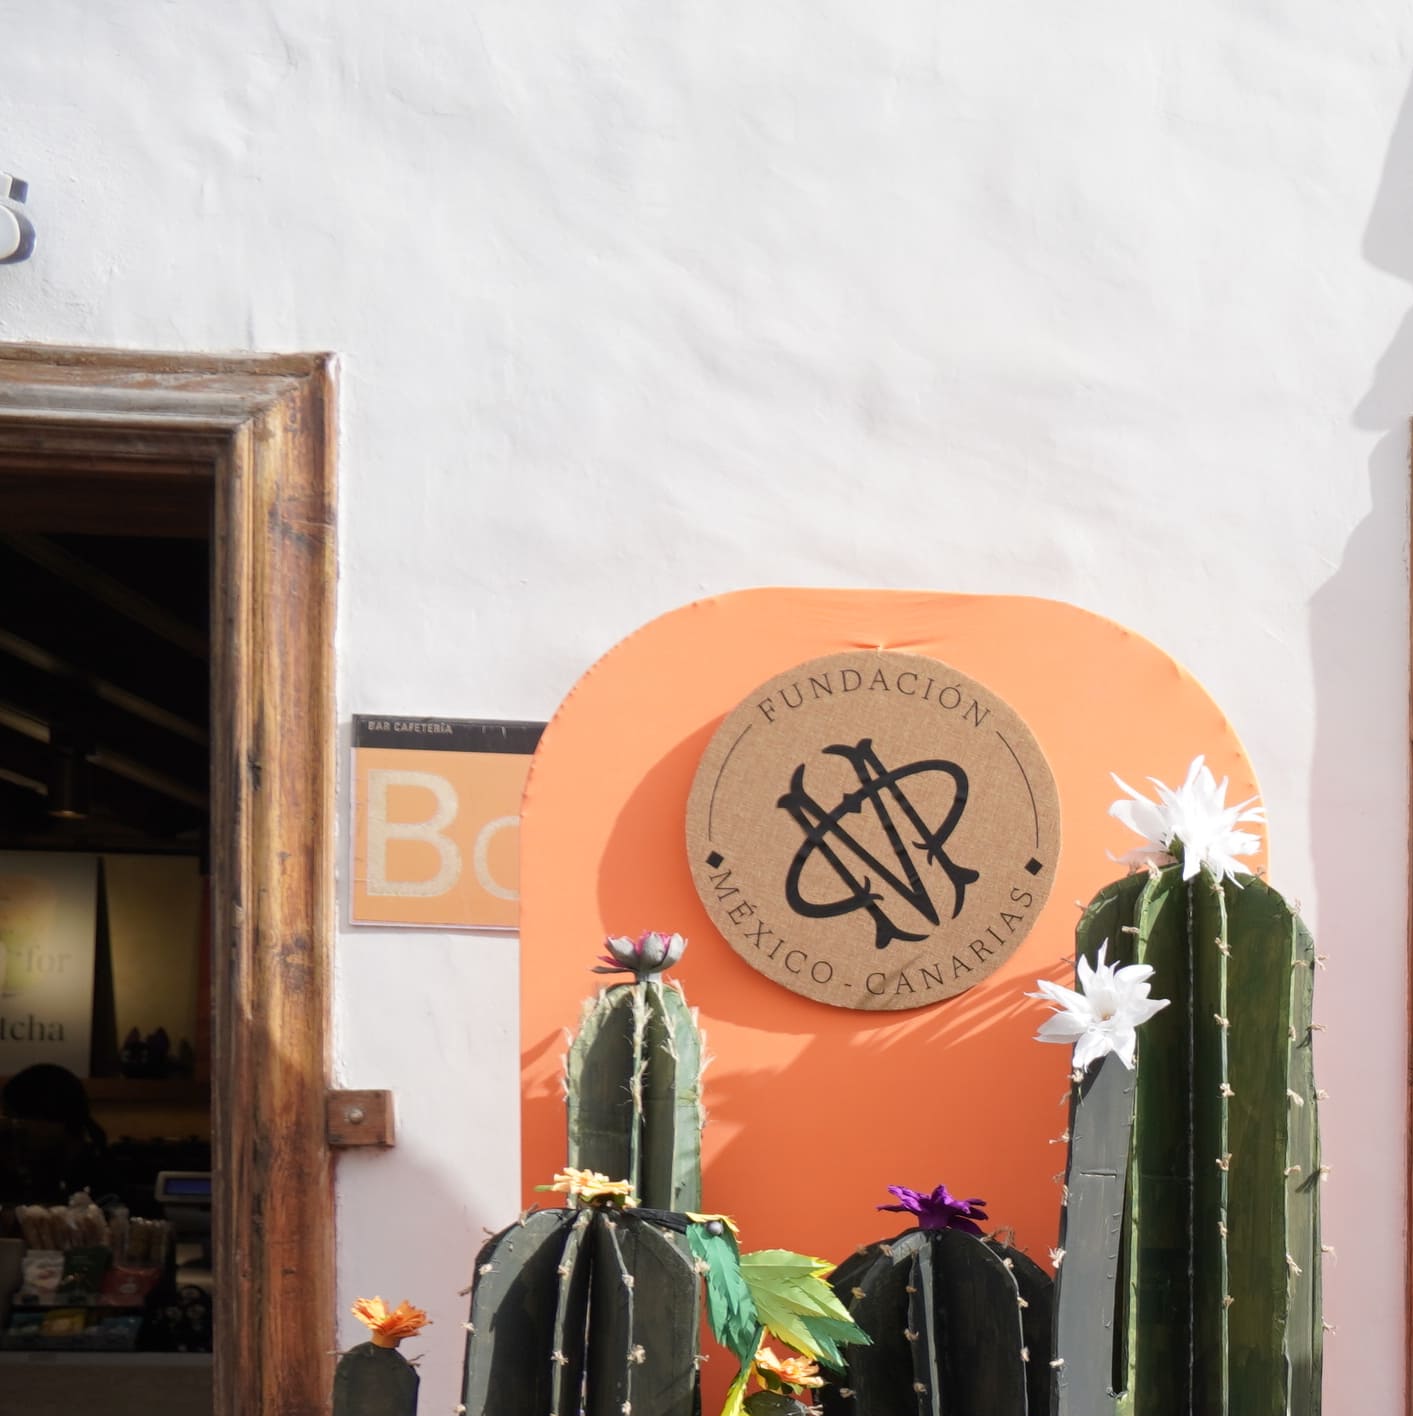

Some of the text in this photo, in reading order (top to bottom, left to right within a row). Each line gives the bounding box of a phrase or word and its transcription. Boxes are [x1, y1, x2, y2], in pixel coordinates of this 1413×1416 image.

[757, 668, 994, 728] FUNDACIÓN
[367, 721, 454, 734] BAR CAFETERÍA
